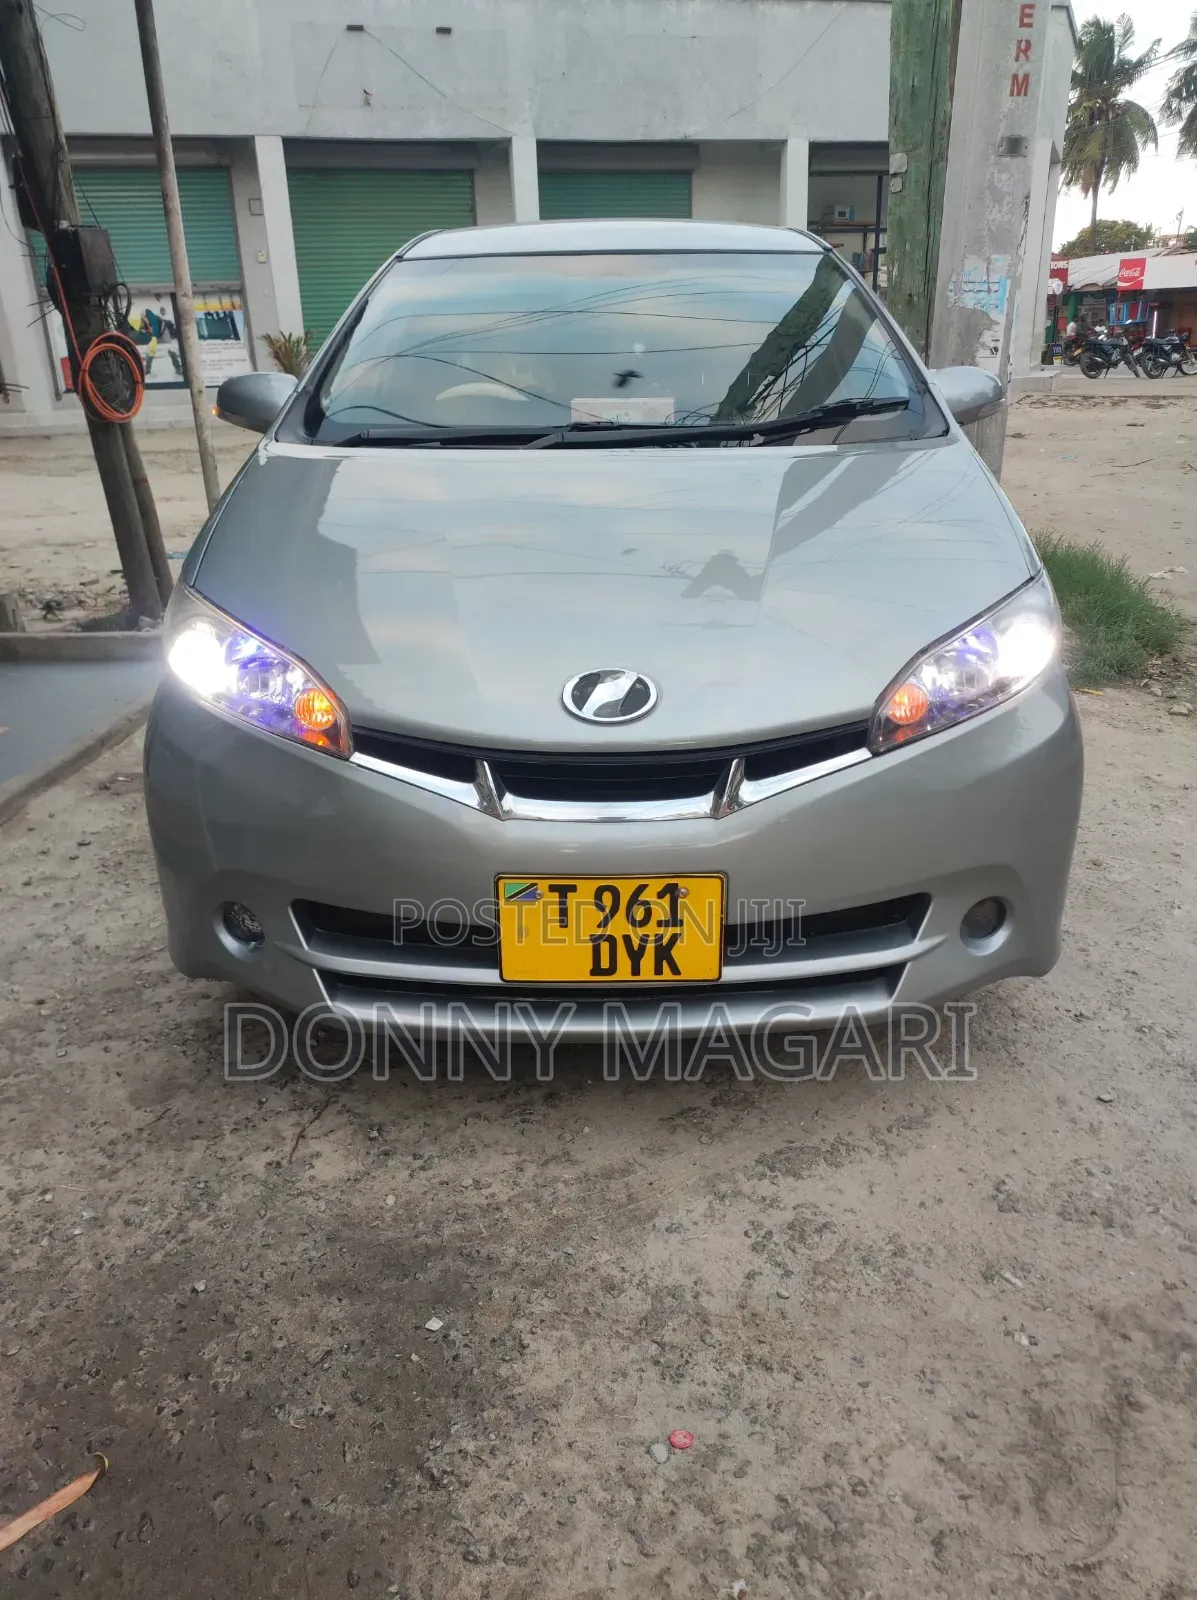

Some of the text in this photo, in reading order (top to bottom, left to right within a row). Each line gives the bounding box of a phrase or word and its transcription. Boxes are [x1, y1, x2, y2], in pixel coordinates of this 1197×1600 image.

[548, 883, 683, 928] T 961
[590, 933, 682, 976] DYK
